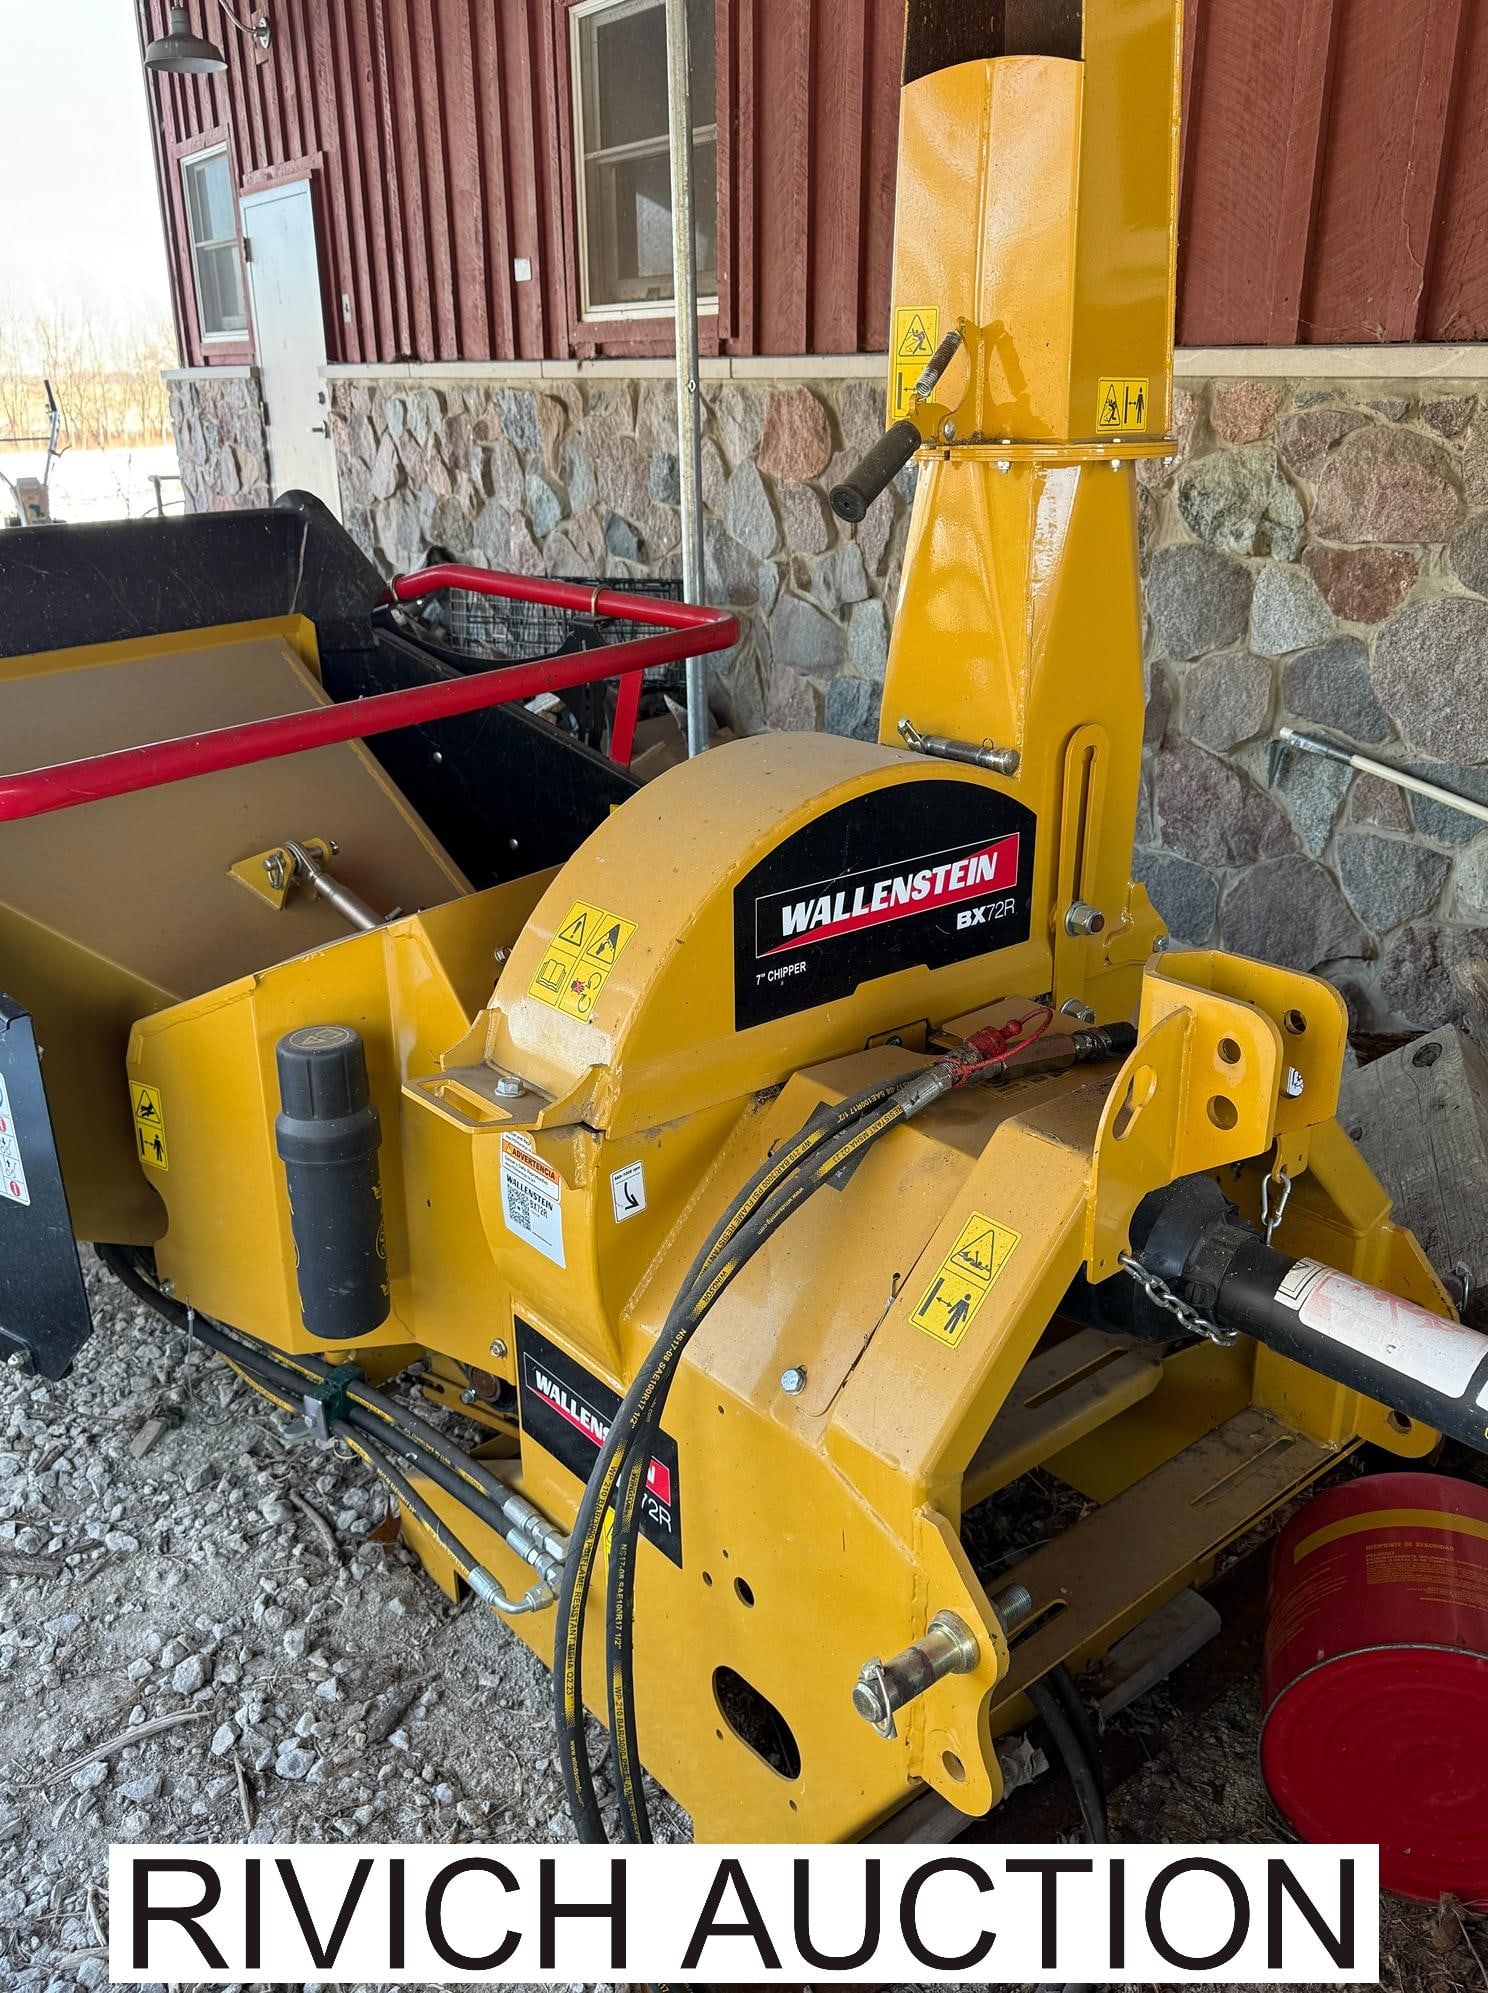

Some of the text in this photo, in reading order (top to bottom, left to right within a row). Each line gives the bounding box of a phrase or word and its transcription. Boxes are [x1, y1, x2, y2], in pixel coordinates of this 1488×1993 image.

[781, 852, 998, 937] WALLENSTEIN
[956, 898, 1015, 930] BX72R
[767, 961, 806, 981] CHIPPER
[850, 1090, 886, 1115] SAE100R17
[801, 1140, 812, 1152] WP
[850, 1132, 870, 1148] MSHA
[511, 1148, 556, 1180] ADVERTENCIA
[790, 1149, 801, 1161] 210
[762, 1160, 790, 1188] BAR/3000
[506, 1173, 554, 1211] WALLENSTEIN
[752, 1187, 764, 1200] PSI
[530, 1198, 548, 1219] BX72R
[735, 1198, 755, 1224] FLAME
[757, 1187, 805, 1235] www.windsormfg.com
[702, 1270, 727, 1303] WINDSOR
[663, 1328, 687, 1362] NS17-08
[637, 1362, 666, 1410] SAE100R17
[629, 1412, 640, 1429] 1/2"
[608, 1466, 618, 1480] WP
[600, 1482, 611, 1498] 210
[626, 1472, 639, 1511] WINDSOR
[586, 1498, 606, 1540] BAR/3000
[618, 1543, 628, 1580] NS17-08
[567, 1591, 582, 1643] RESISTANT
[614, 1581, 624, 1631] SAE100R17
[614, 1686, 622, 1700] WP
[615, 1702, 623, 1716] 210
